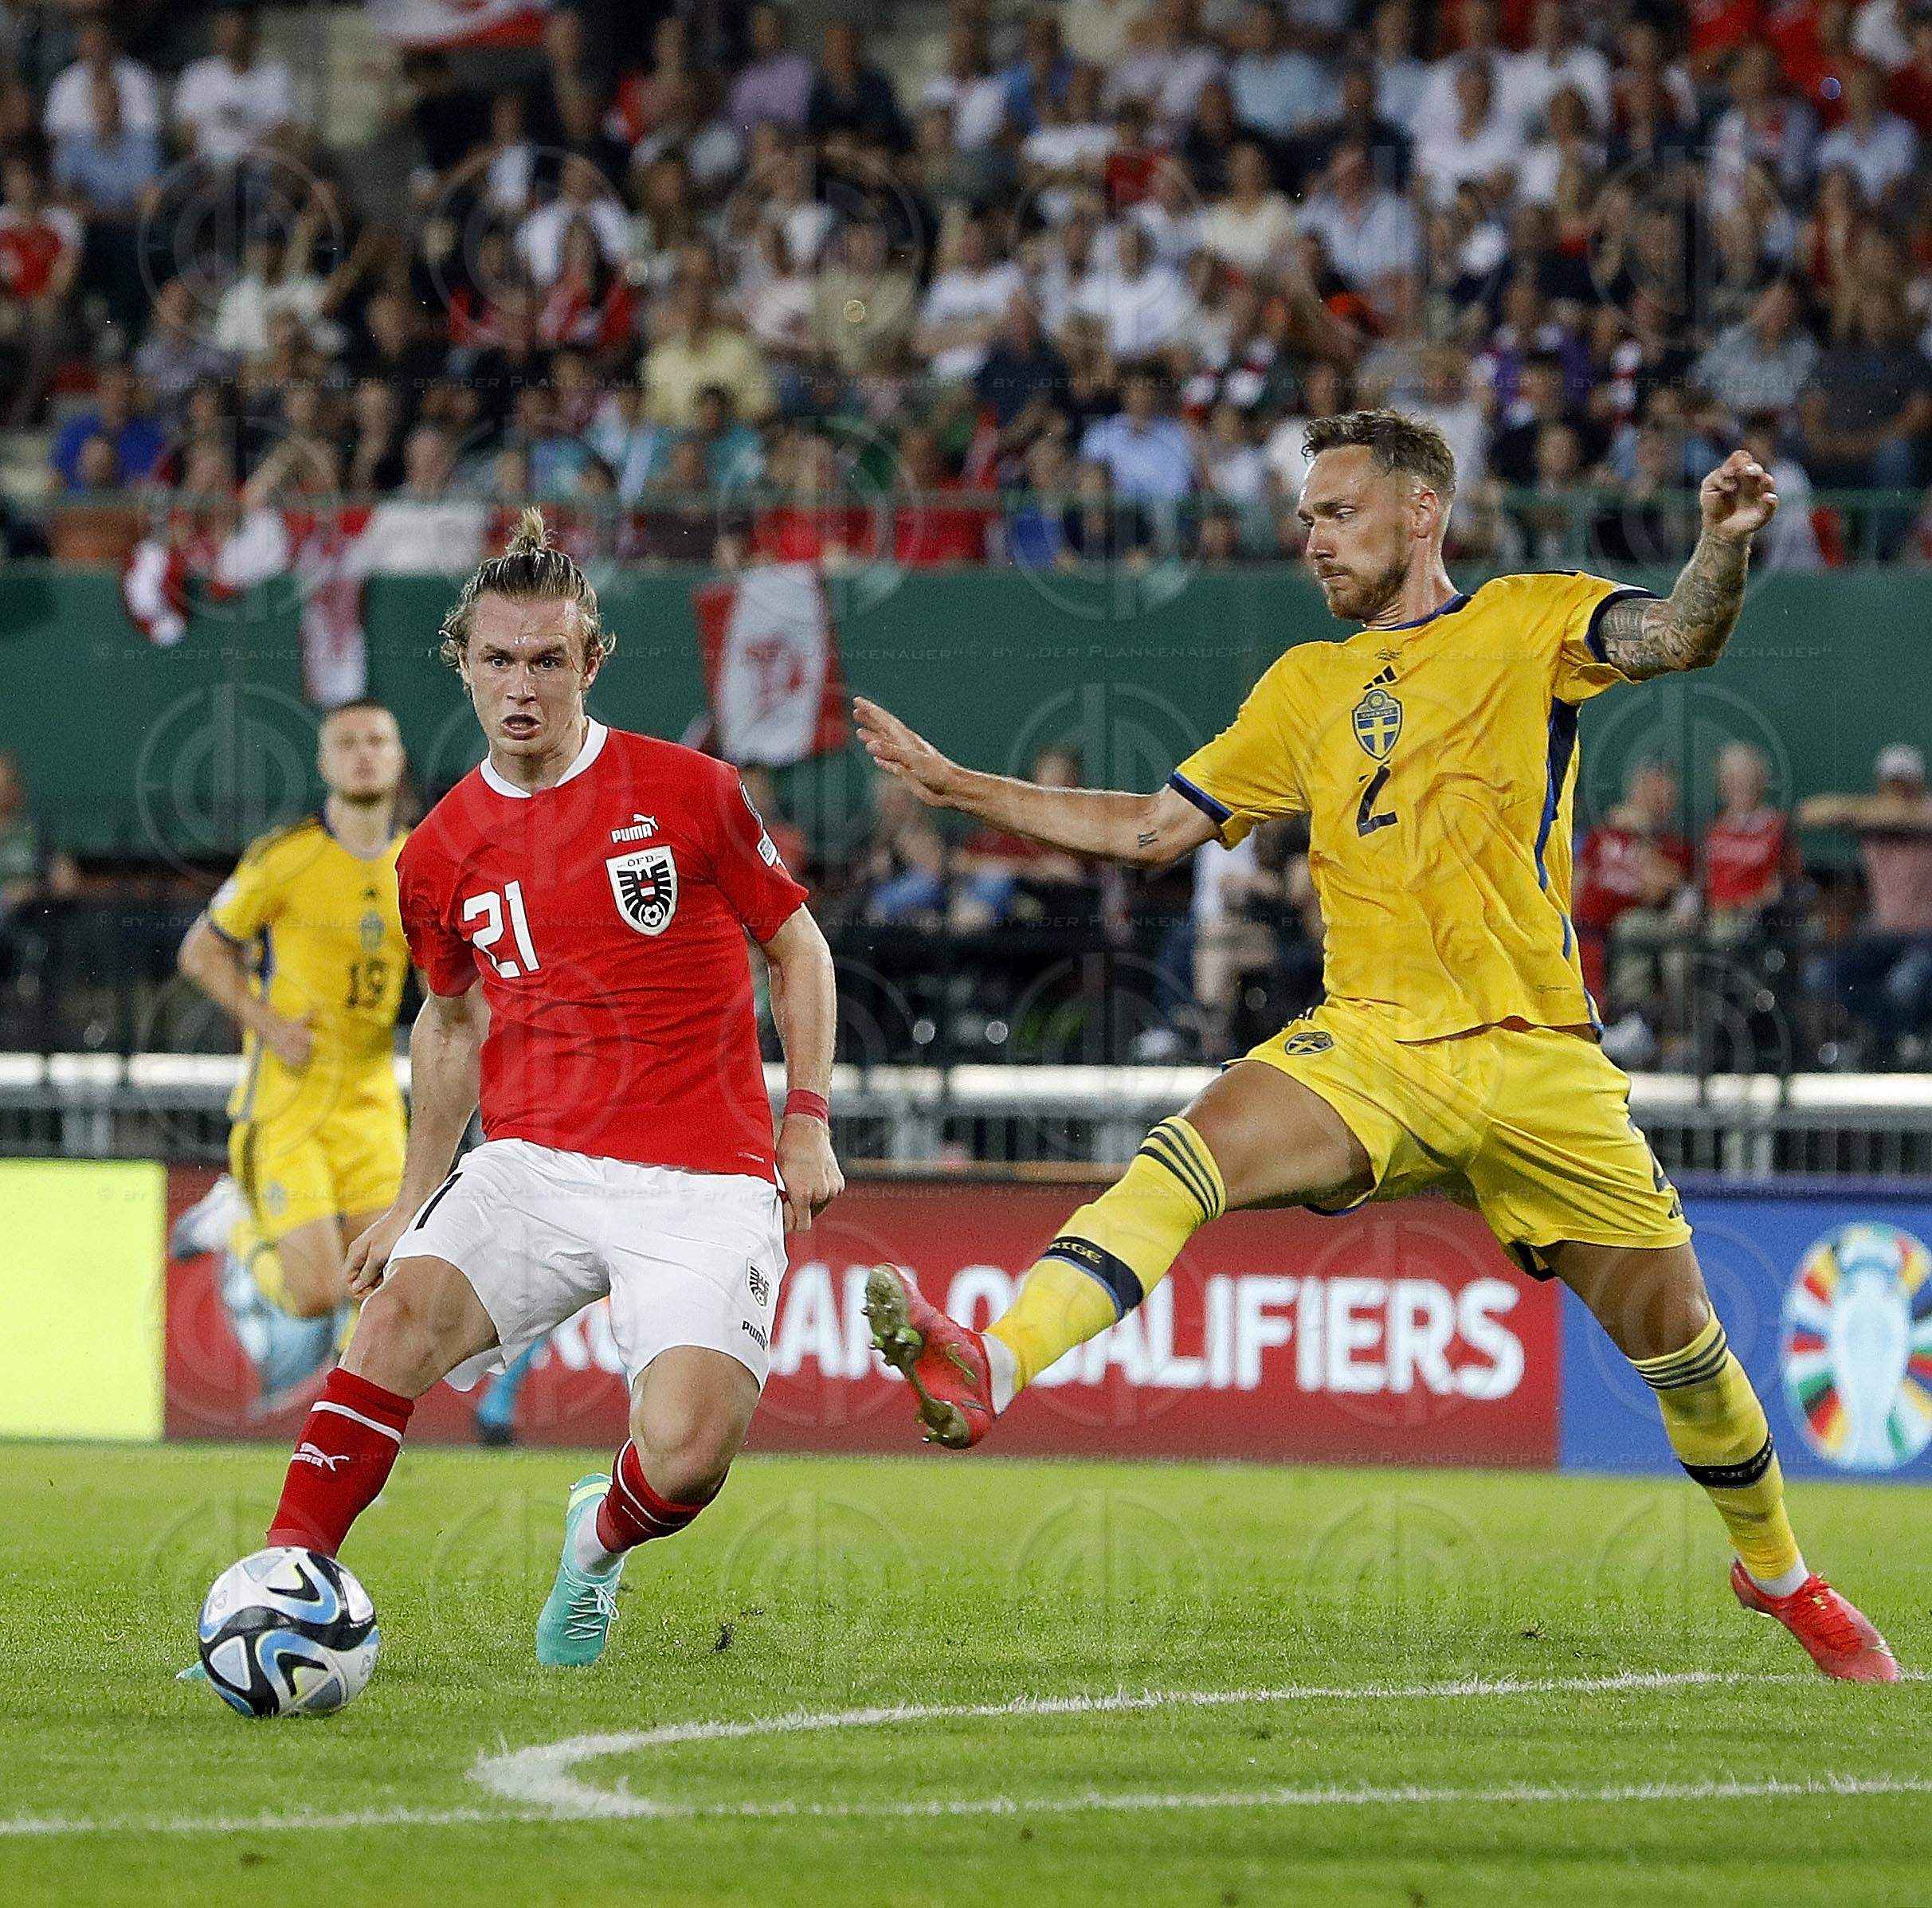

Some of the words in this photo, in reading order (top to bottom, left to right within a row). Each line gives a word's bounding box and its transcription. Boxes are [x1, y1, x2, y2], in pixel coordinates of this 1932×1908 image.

[611, 823, 652, 844] PUMA
[1356, 758, 1399, 837] 2
[462, 880, 540, 979] 21
